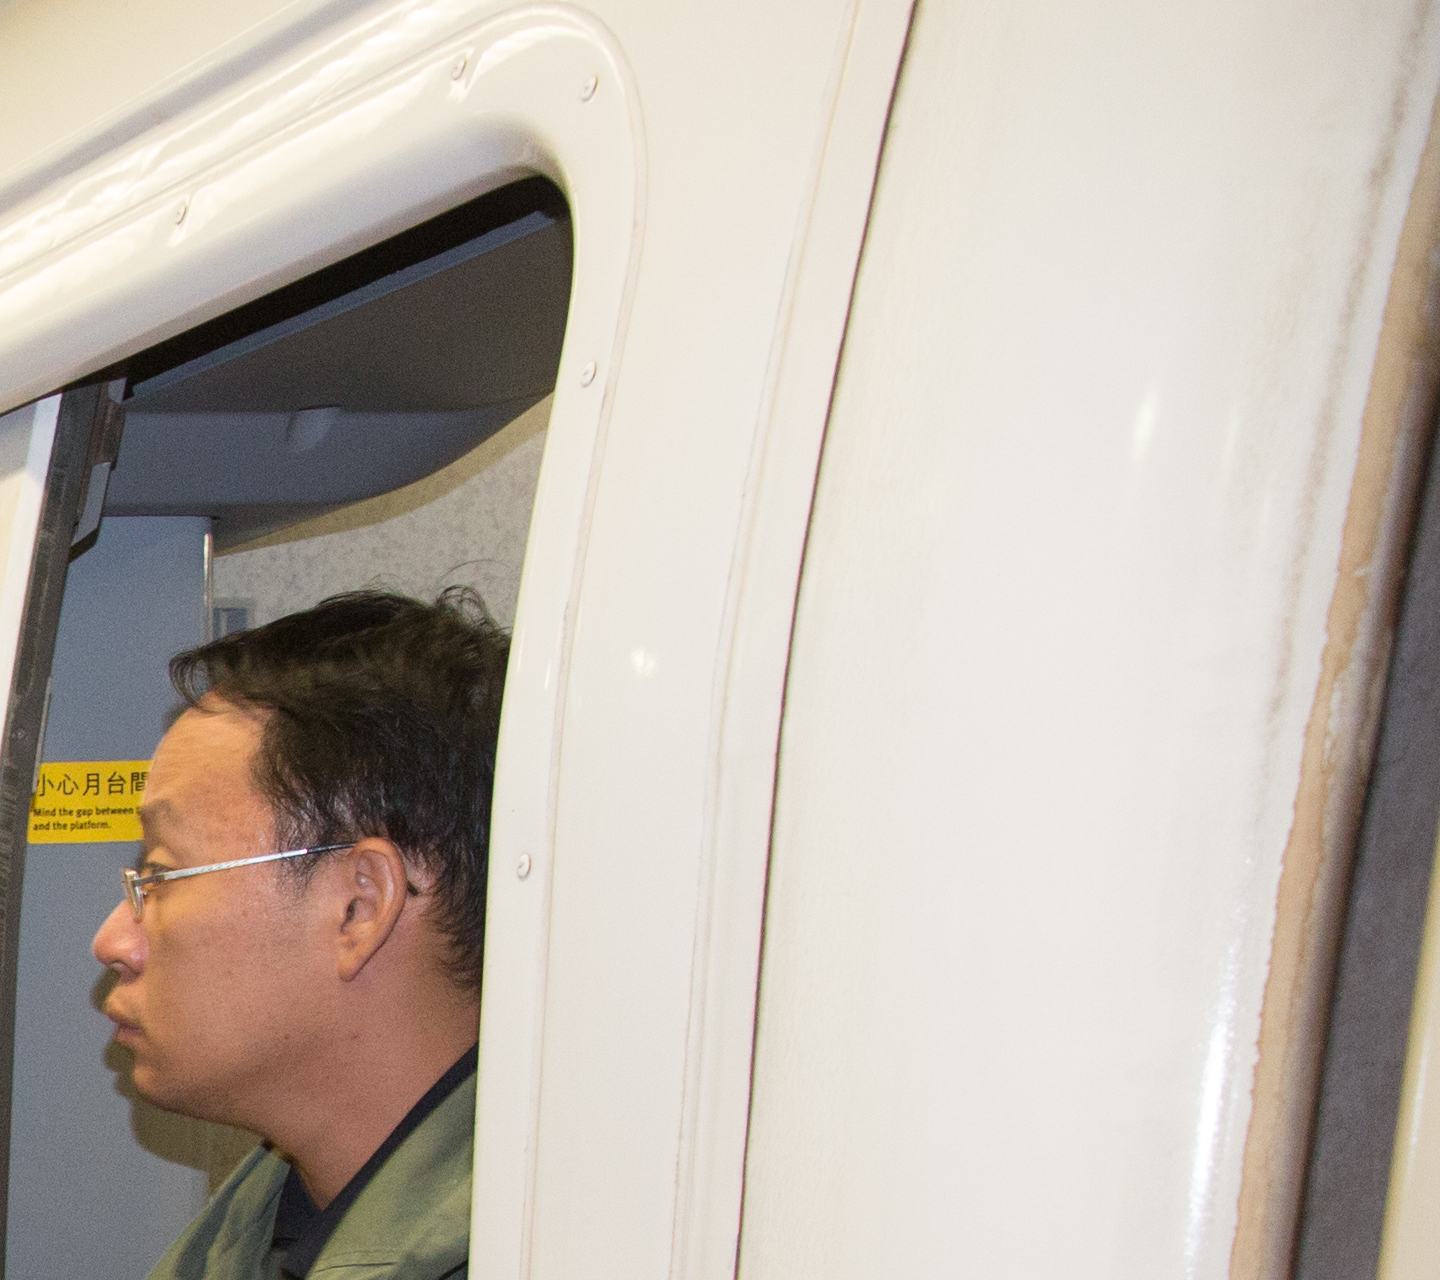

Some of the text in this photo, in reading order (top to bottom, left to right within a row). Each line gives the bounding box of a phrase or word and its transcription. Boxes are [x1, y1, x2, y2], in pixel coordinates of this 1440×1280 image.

[33, 808, 57, 817] Mind
[58, 807, 74, 816] the
[75, 807, 94, 818] gap
[95, 806, 134, 815] between
[33, 821, 51, 831] and
[52, 821, 68, 830] the
